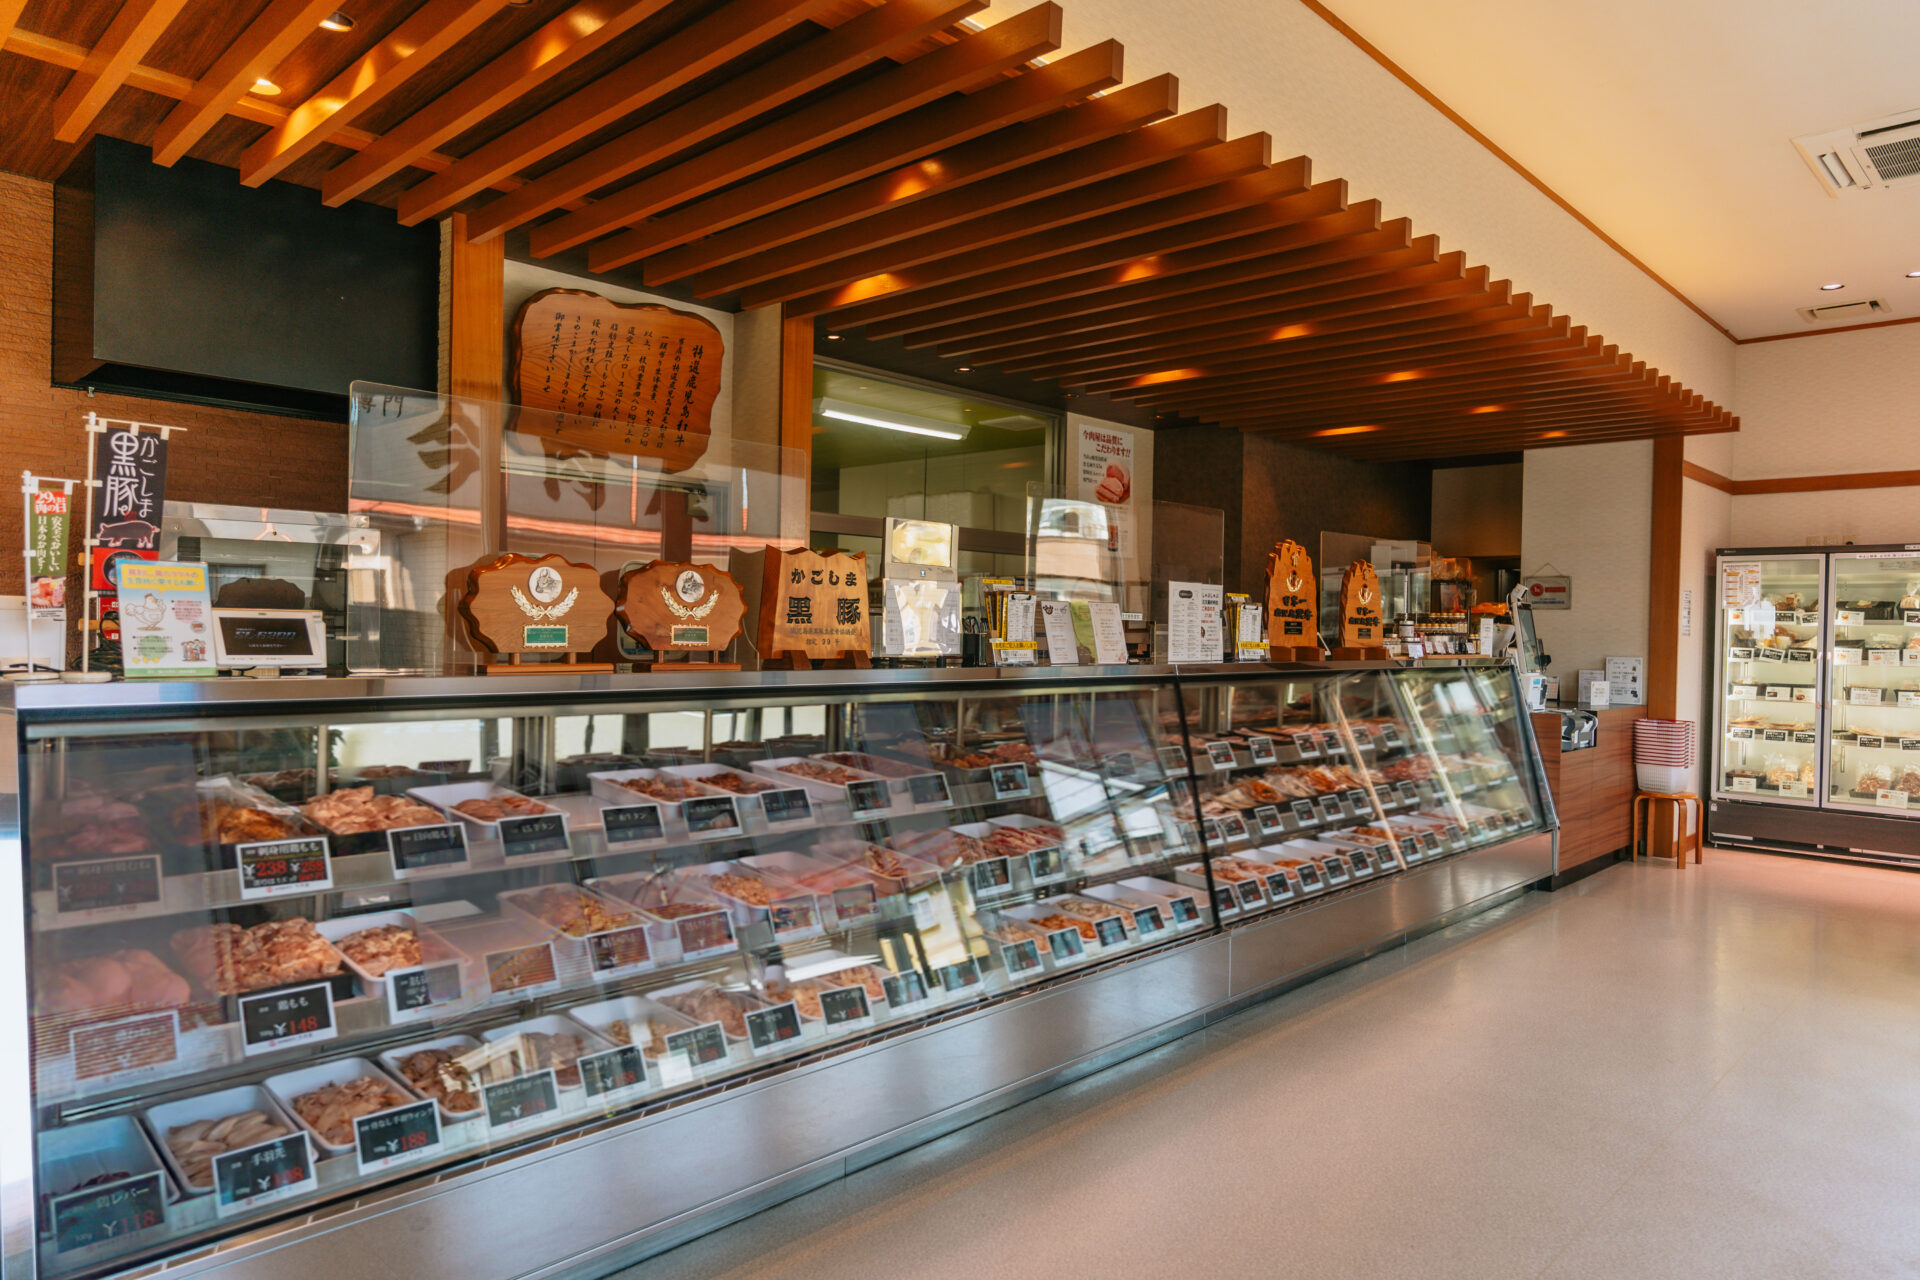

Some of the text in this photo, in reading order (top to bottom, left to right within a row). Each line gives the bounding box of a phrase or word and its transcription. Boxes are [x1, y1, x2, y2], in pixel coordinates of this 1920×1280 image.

[543, 311, 565, 393] 御賞味下さいませ
[674, 345, 704, 447] 特選鹿児島和牛
[103, 431, 140, 517] 黒豚
[139, 435, 160, 518] かごしま
[49, 515, 62, 572] 安全でおいしい
[791, 567, 857, 587] かごしま
[786, 596, 861, 625] 黒豚
[243, 860, 288, 879] ¥238
[273, 1015, 319, 1037] ¥148
[386, 1130, 428, 1153] ¥188
[102, 1208, 156, 1238] ¥118
